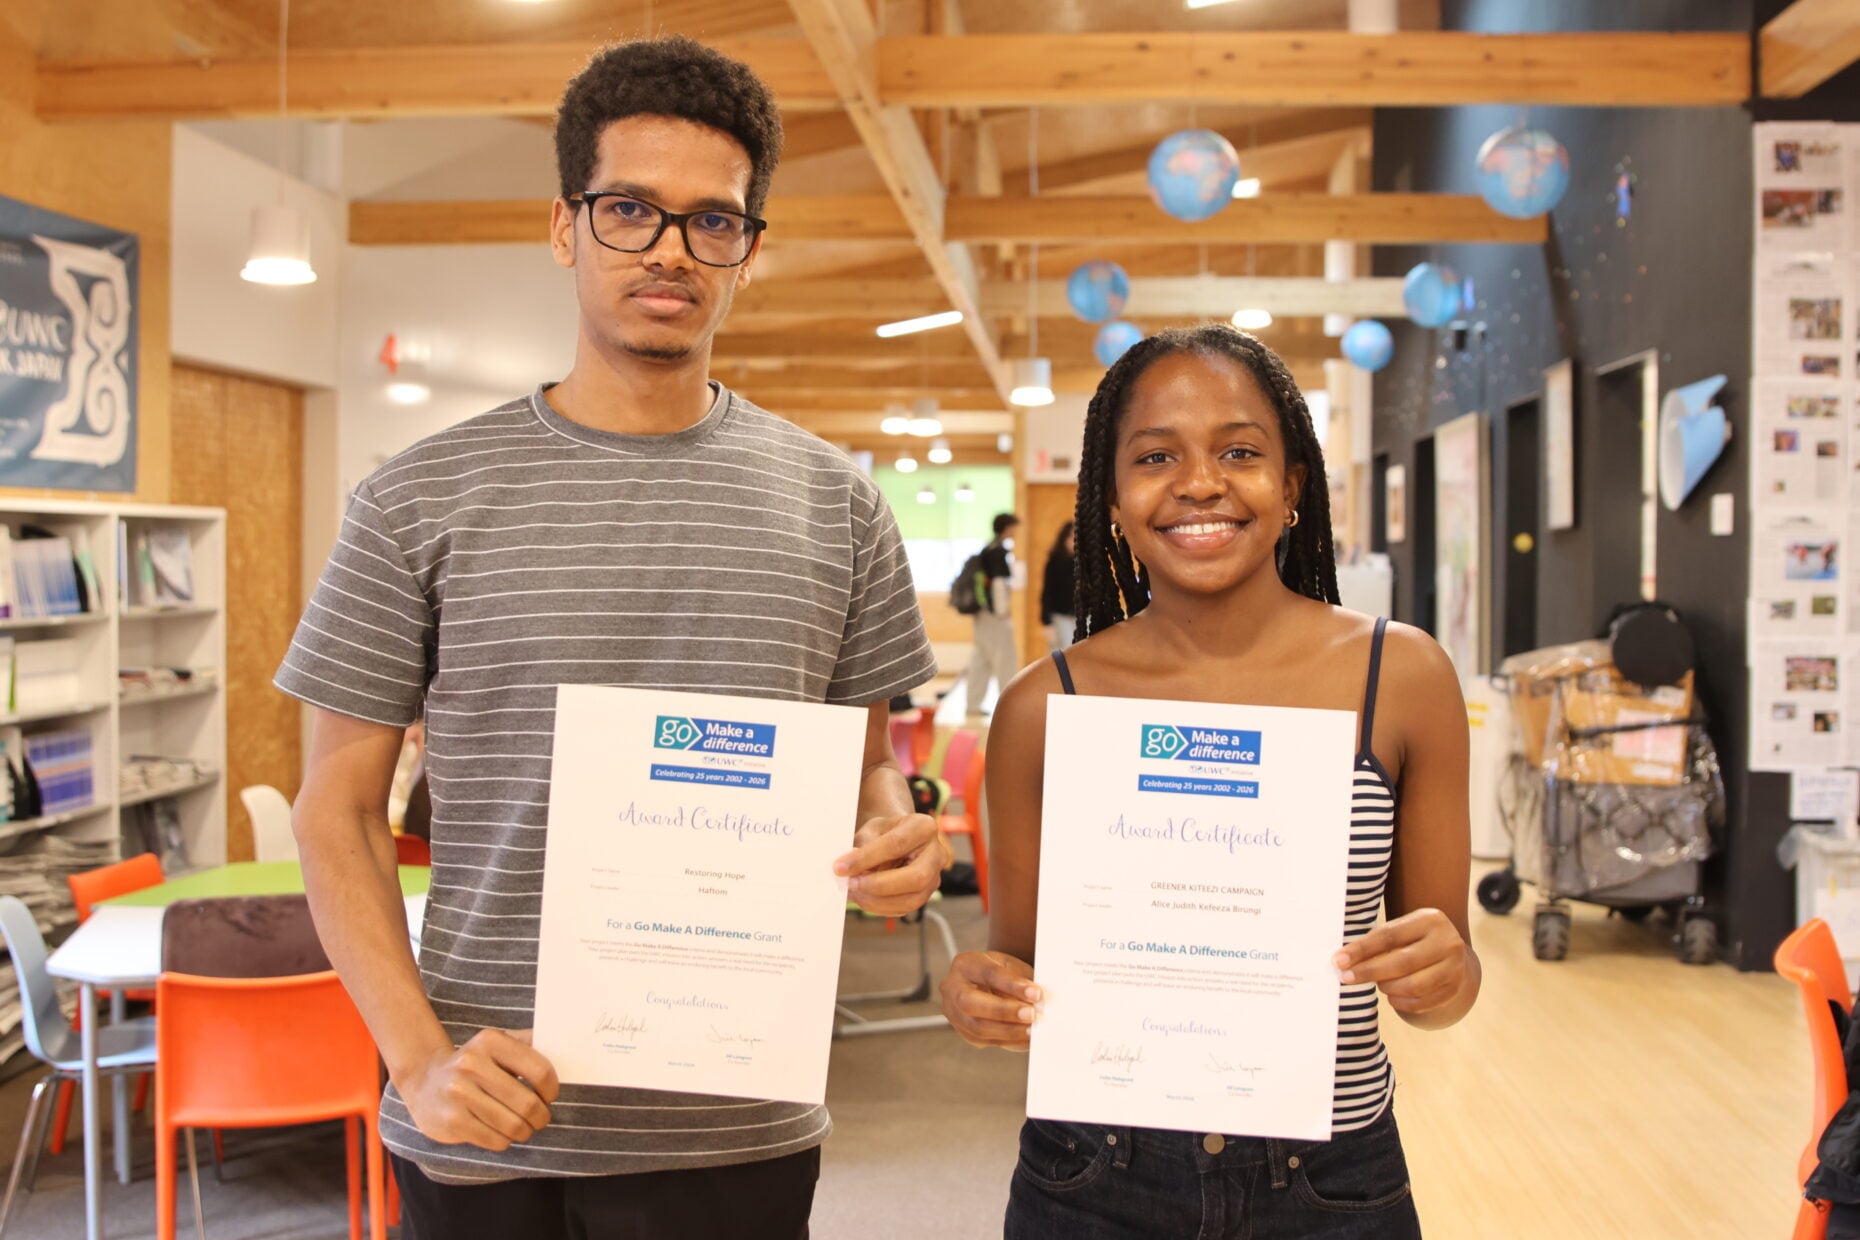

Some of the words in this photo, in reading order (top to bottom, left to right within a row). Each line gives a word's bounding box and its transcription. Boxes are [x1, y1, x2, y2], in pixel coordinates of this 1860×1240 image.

[659, 719, 692, 746] go
[706, 722, 743, 738] Make
[745, 728, 754, 739] a
[1191, 730, 1228, 745] Make
[1231, 735, 1239, 745] a
[703, 737, 768, 754] difference
[1145, 728, 1178, 755] go
[1189, 745, 1254, 761] difference
[655, 769, 695, 780] Celebrating
[695, 772, 704, 780] 25
[705, 774, 724, 782] years
[725, 775, 743, 783] 2002
[748, 777, 766, 785] 2026
[1143, 779, 1182, 790] Celebrating
[1213, 784, 1231, 792] 2002
[1236, 786, 1254, 794] 2026
[619, 801, 684, 828] Award
[690, 806, 794, 842] Certificate
[1108, 813, 1173, 840] Award
[1180, 817, 1285, 854] Certificate
[684, 868, 722, 879] Restoring
[724, 872, 746, 880] Hope
[698, 887, 728, 896] Haftom
[1150, 881, 1186, 891] GREENER
[1189, 883, 1218, 893] KITEEZI
[1220, 886, 1264, 896] CAMPAIGN
[1151, 900, 1170, 908] Alice
[1172, 901, 1196, 910] Judith
[1233, 905, 1261, 915] Birungi
[607, 919, 623, 930] For
[634, 921, 650, 931] Go
[652, 922, 682, 934] Make
[684, 925, 693, 935] A
[695, 926, 751, 940] Difference
[753, 931, 782, 943] Grant
[1100, 939, 1117, 949] For
[1128, 941, 1144, 951] Go
[1146, 942, 1176, 954] Make
[1179, 944, 1187, 954] A
[1189, 945, 1247, 959] Difference
[1249, 949, 1279, 961] Grant
